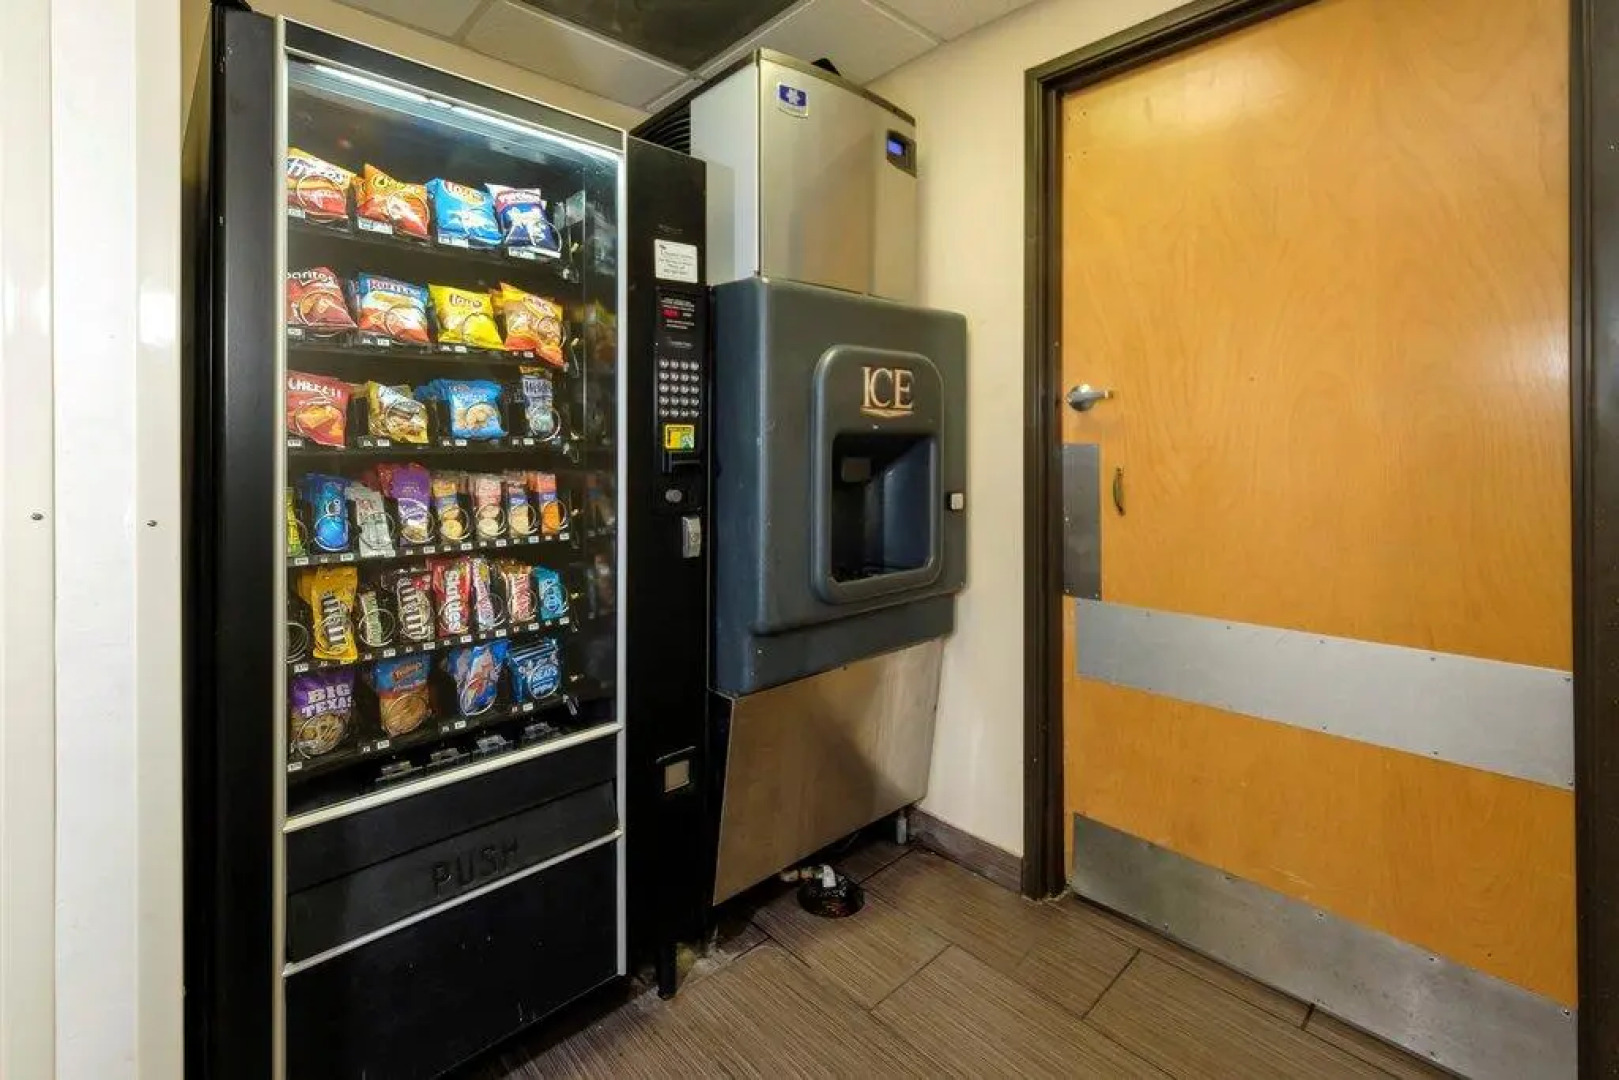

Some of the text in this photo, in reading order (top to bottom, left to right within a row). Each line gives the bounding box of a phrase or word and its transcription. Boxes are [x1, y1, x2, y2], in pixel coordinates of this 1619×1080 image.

[861, 366, 914, 409] ICE
[307, 683, 351, 704] BIG
[432, 836, 518, 899] PUSH
